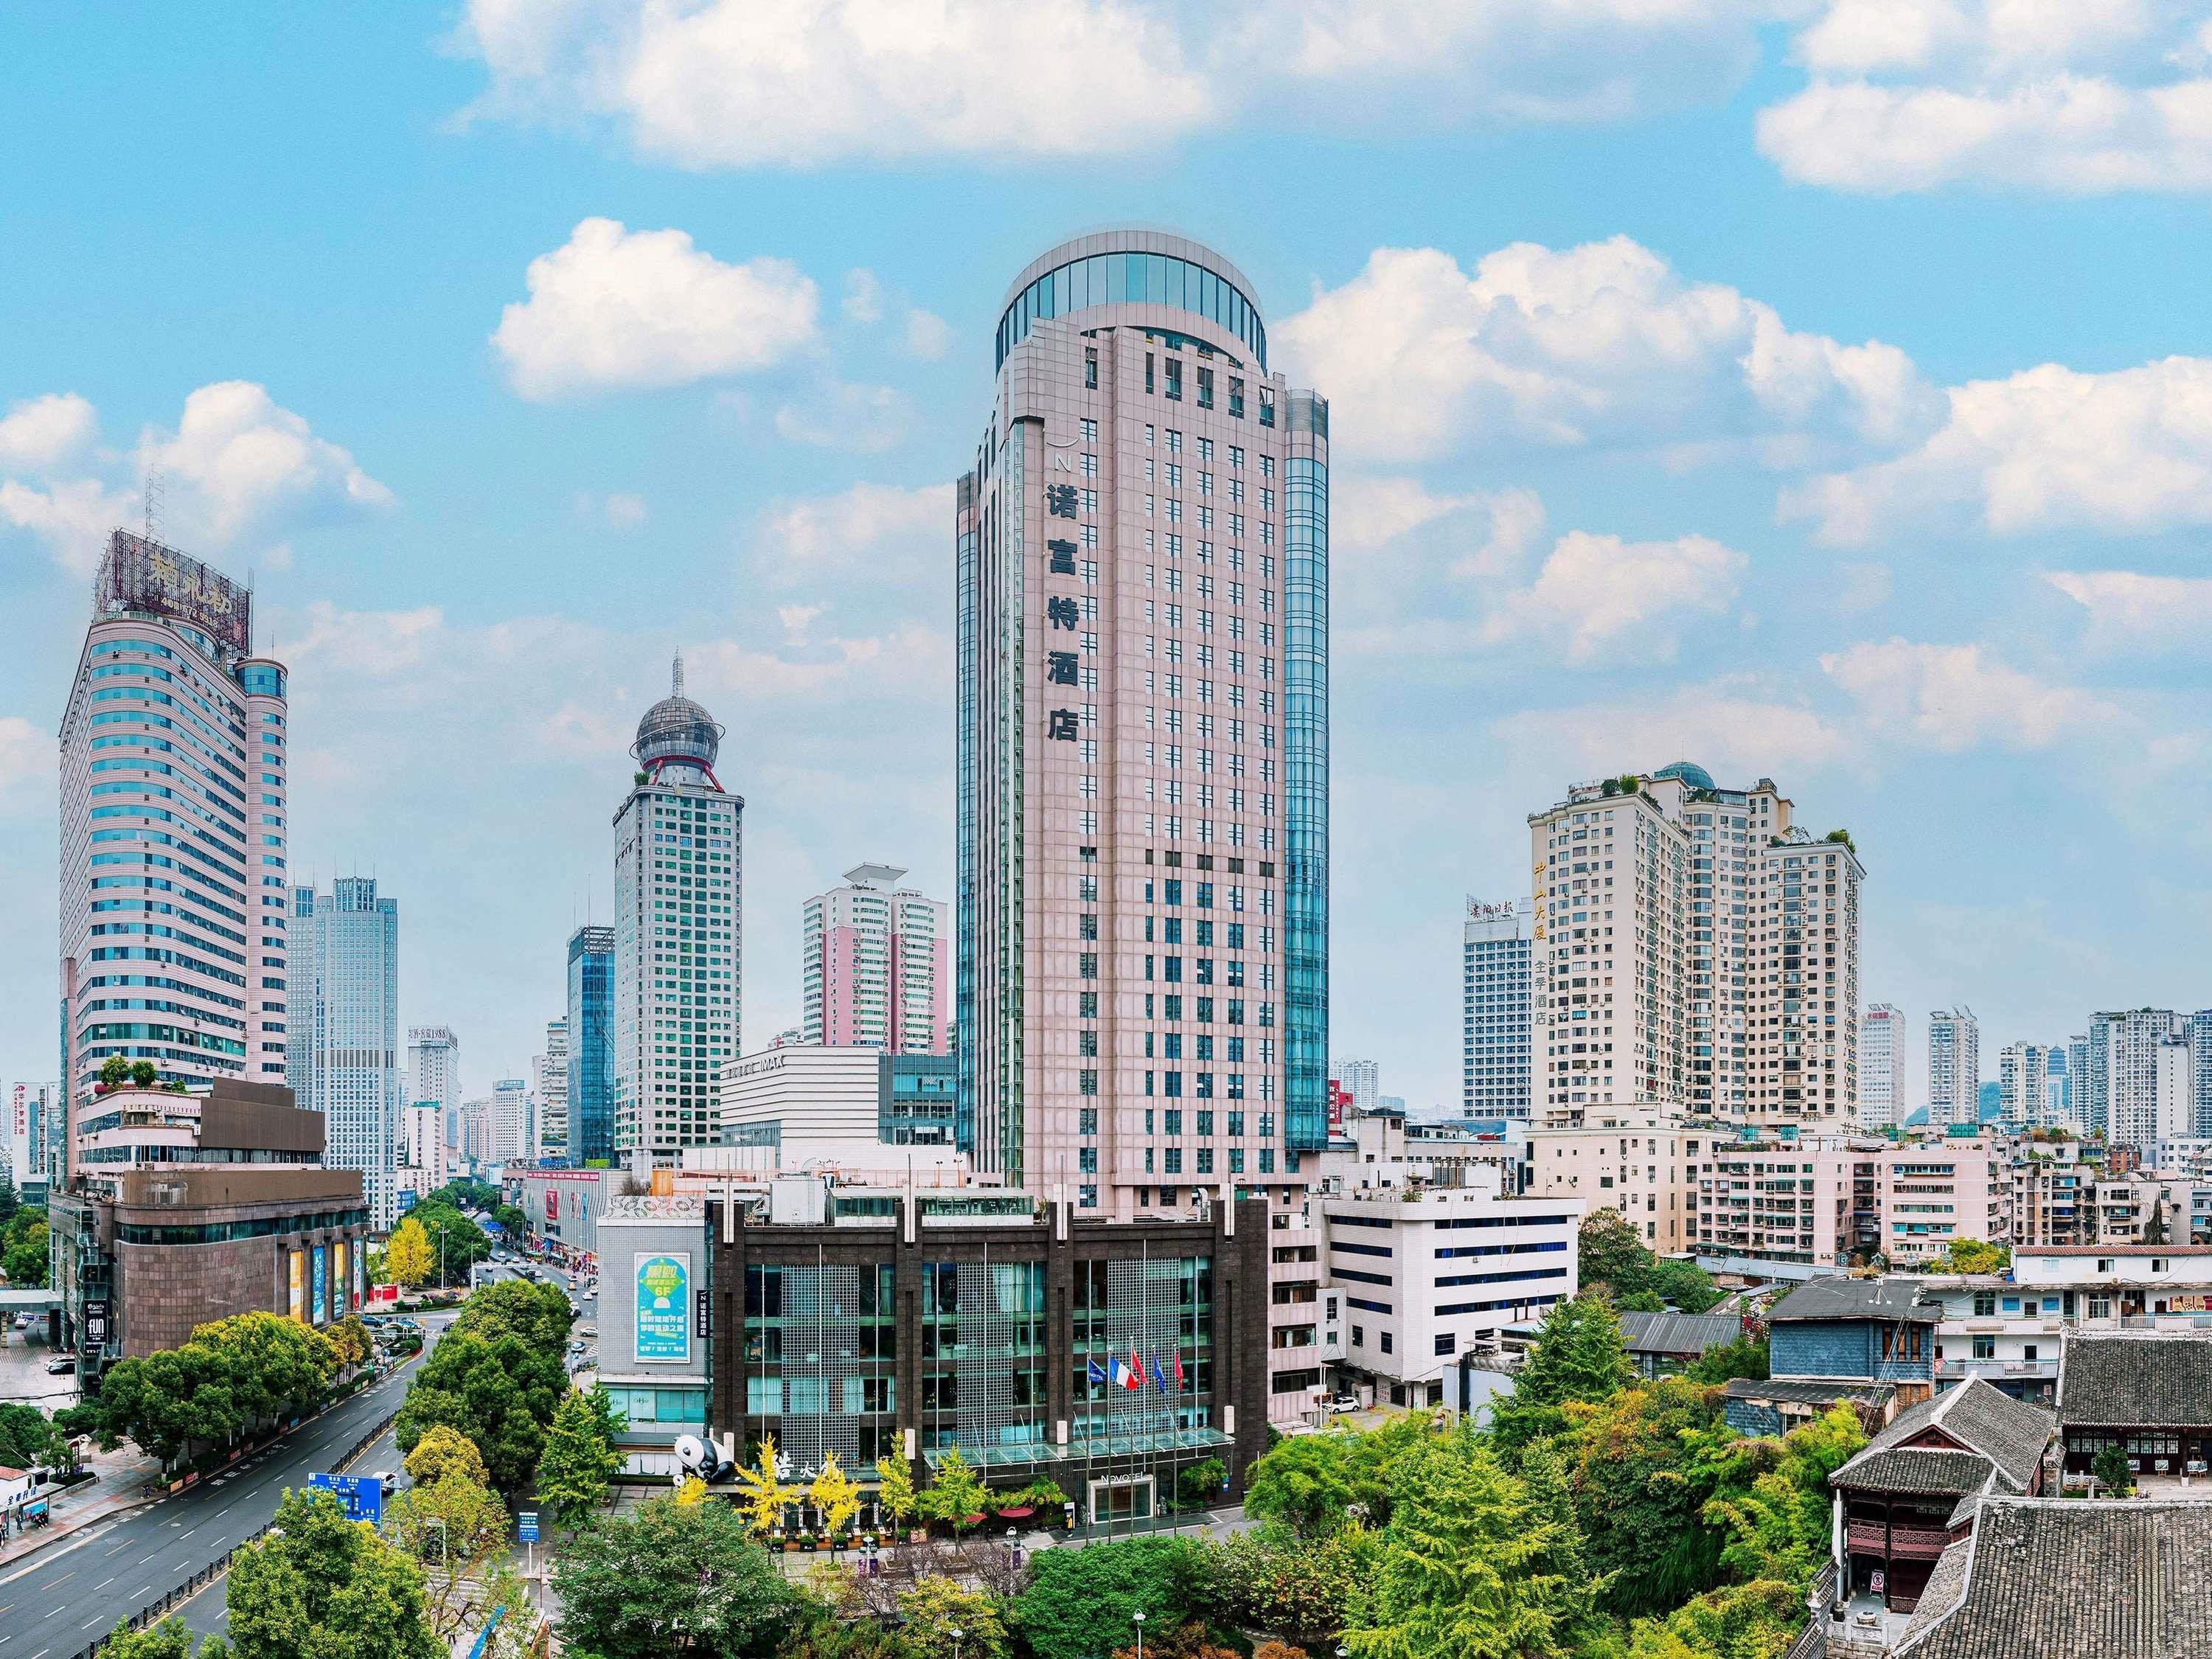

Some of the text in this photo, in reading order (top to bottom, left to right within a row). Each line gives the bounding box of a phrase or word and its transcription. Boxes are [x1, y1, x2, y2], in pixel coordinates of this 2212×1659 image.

[1047, 453, 1079, 742] N 诺富特酒店
[1470, 900, 1514, 919] 贵阳日报
[1533, 860, 1547, 942] 中山大厦
[1534, 960, 1547, 1026] 全季酒店
[761, 1055, 784, 1072] IMAX
[654, 1286, 671, 1296] 6F
[1101, 1471, 1143, 1484] NOVOTEL
